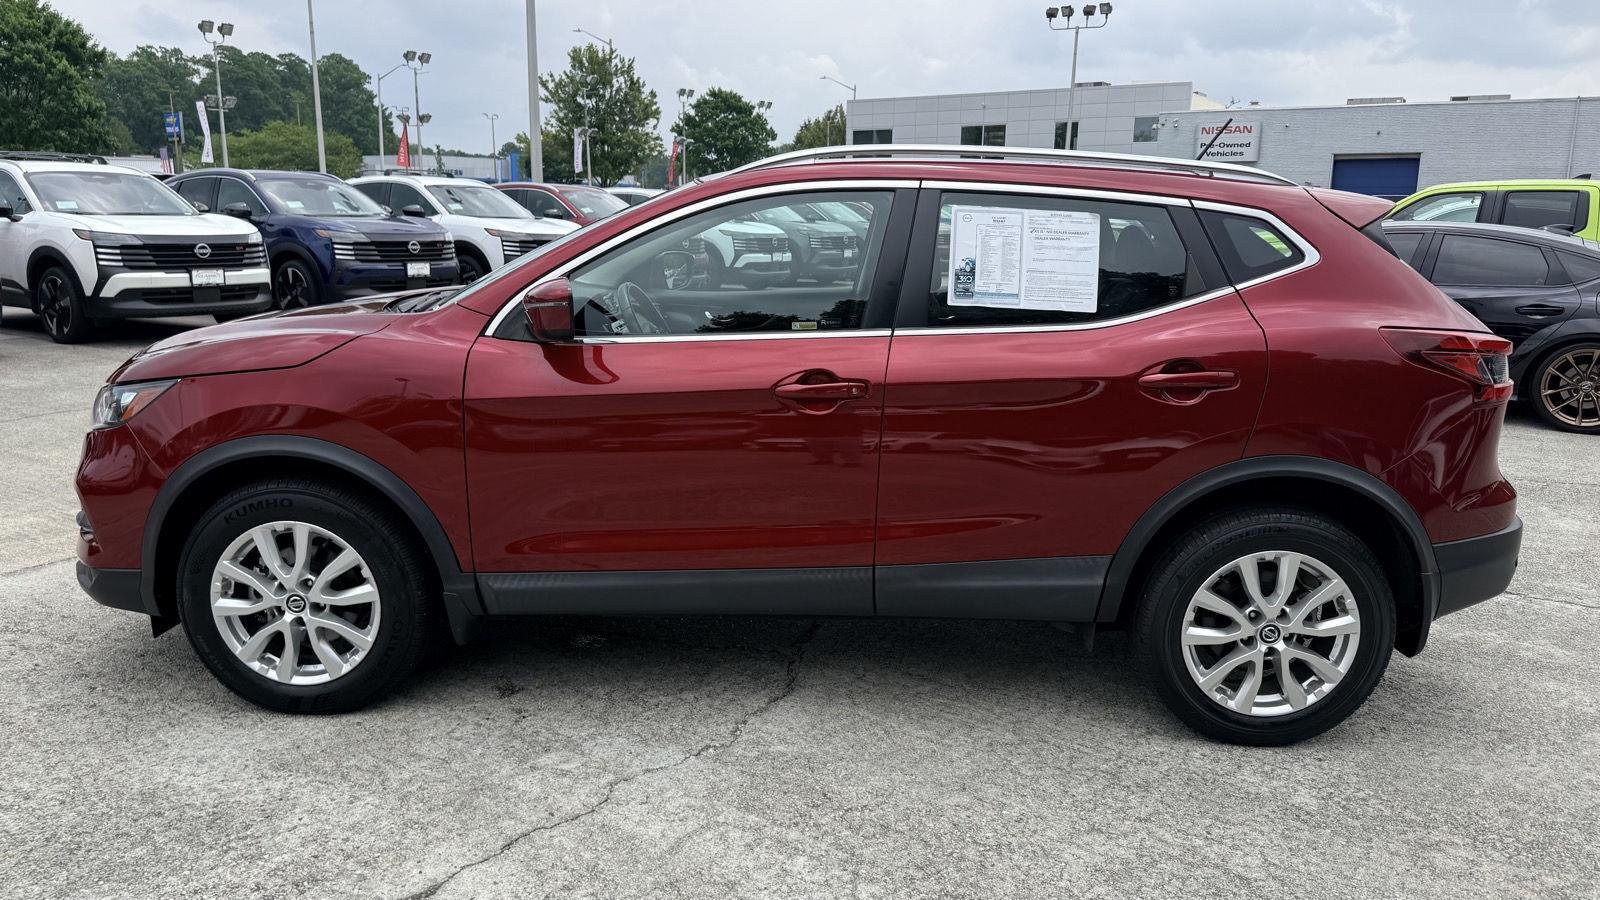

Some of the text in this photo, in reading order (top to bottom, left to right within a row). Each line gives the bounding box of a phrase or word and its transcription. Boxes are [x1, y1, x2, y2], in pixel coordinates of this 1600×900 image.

[1201, 126, 1252, 134] NISSAN
[1200, 141, 1251, 149] Pe-Owned
[224, 498, 293, 524] KUMHO
